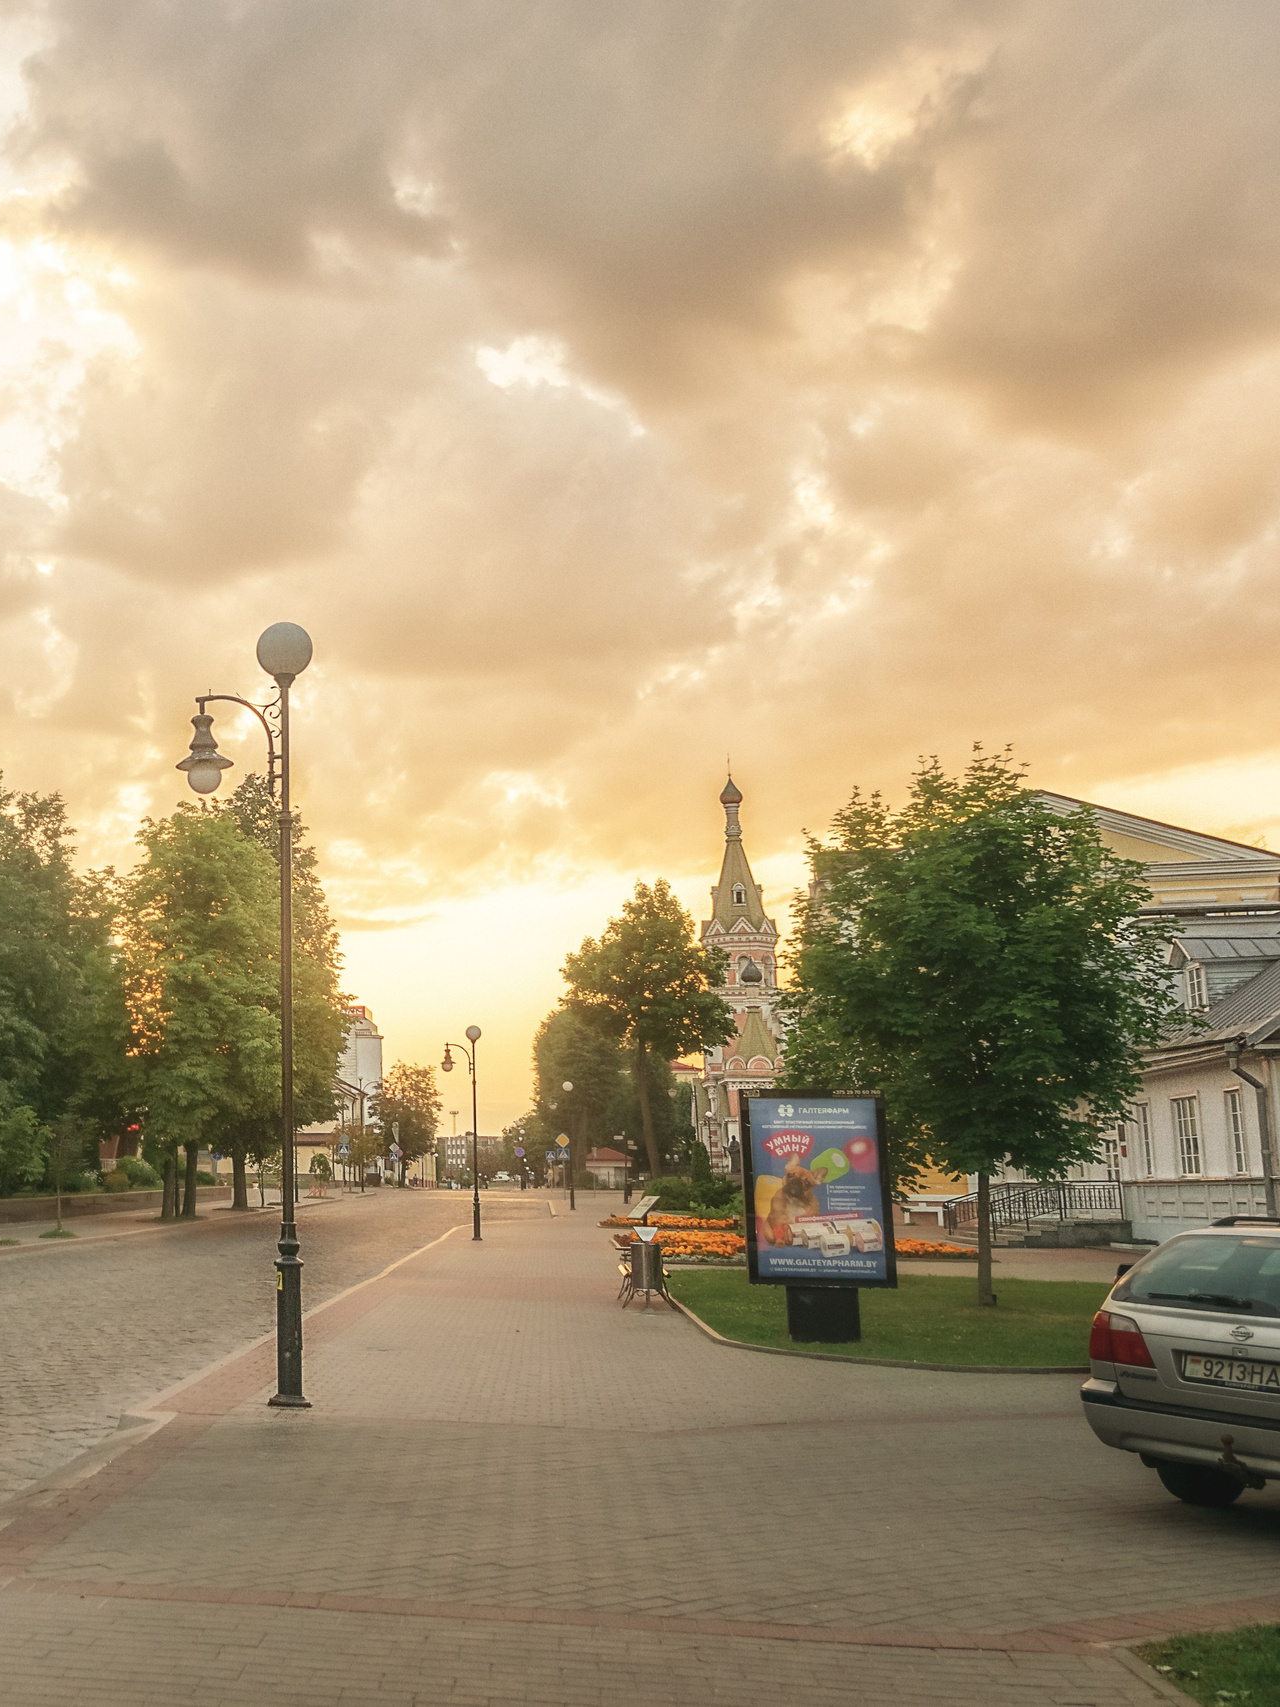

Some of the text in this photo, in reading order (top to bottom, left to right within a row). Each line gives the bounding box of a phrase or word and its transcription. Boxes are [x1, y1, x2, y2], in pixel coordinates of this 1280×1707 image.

[766, 1134, 810, 1150] УМНЫЙ
[775, 1143, 808, 1156] БИНТ
[769, 1258, 877, 1268] WWW.GALTEYAPHARM.BY
